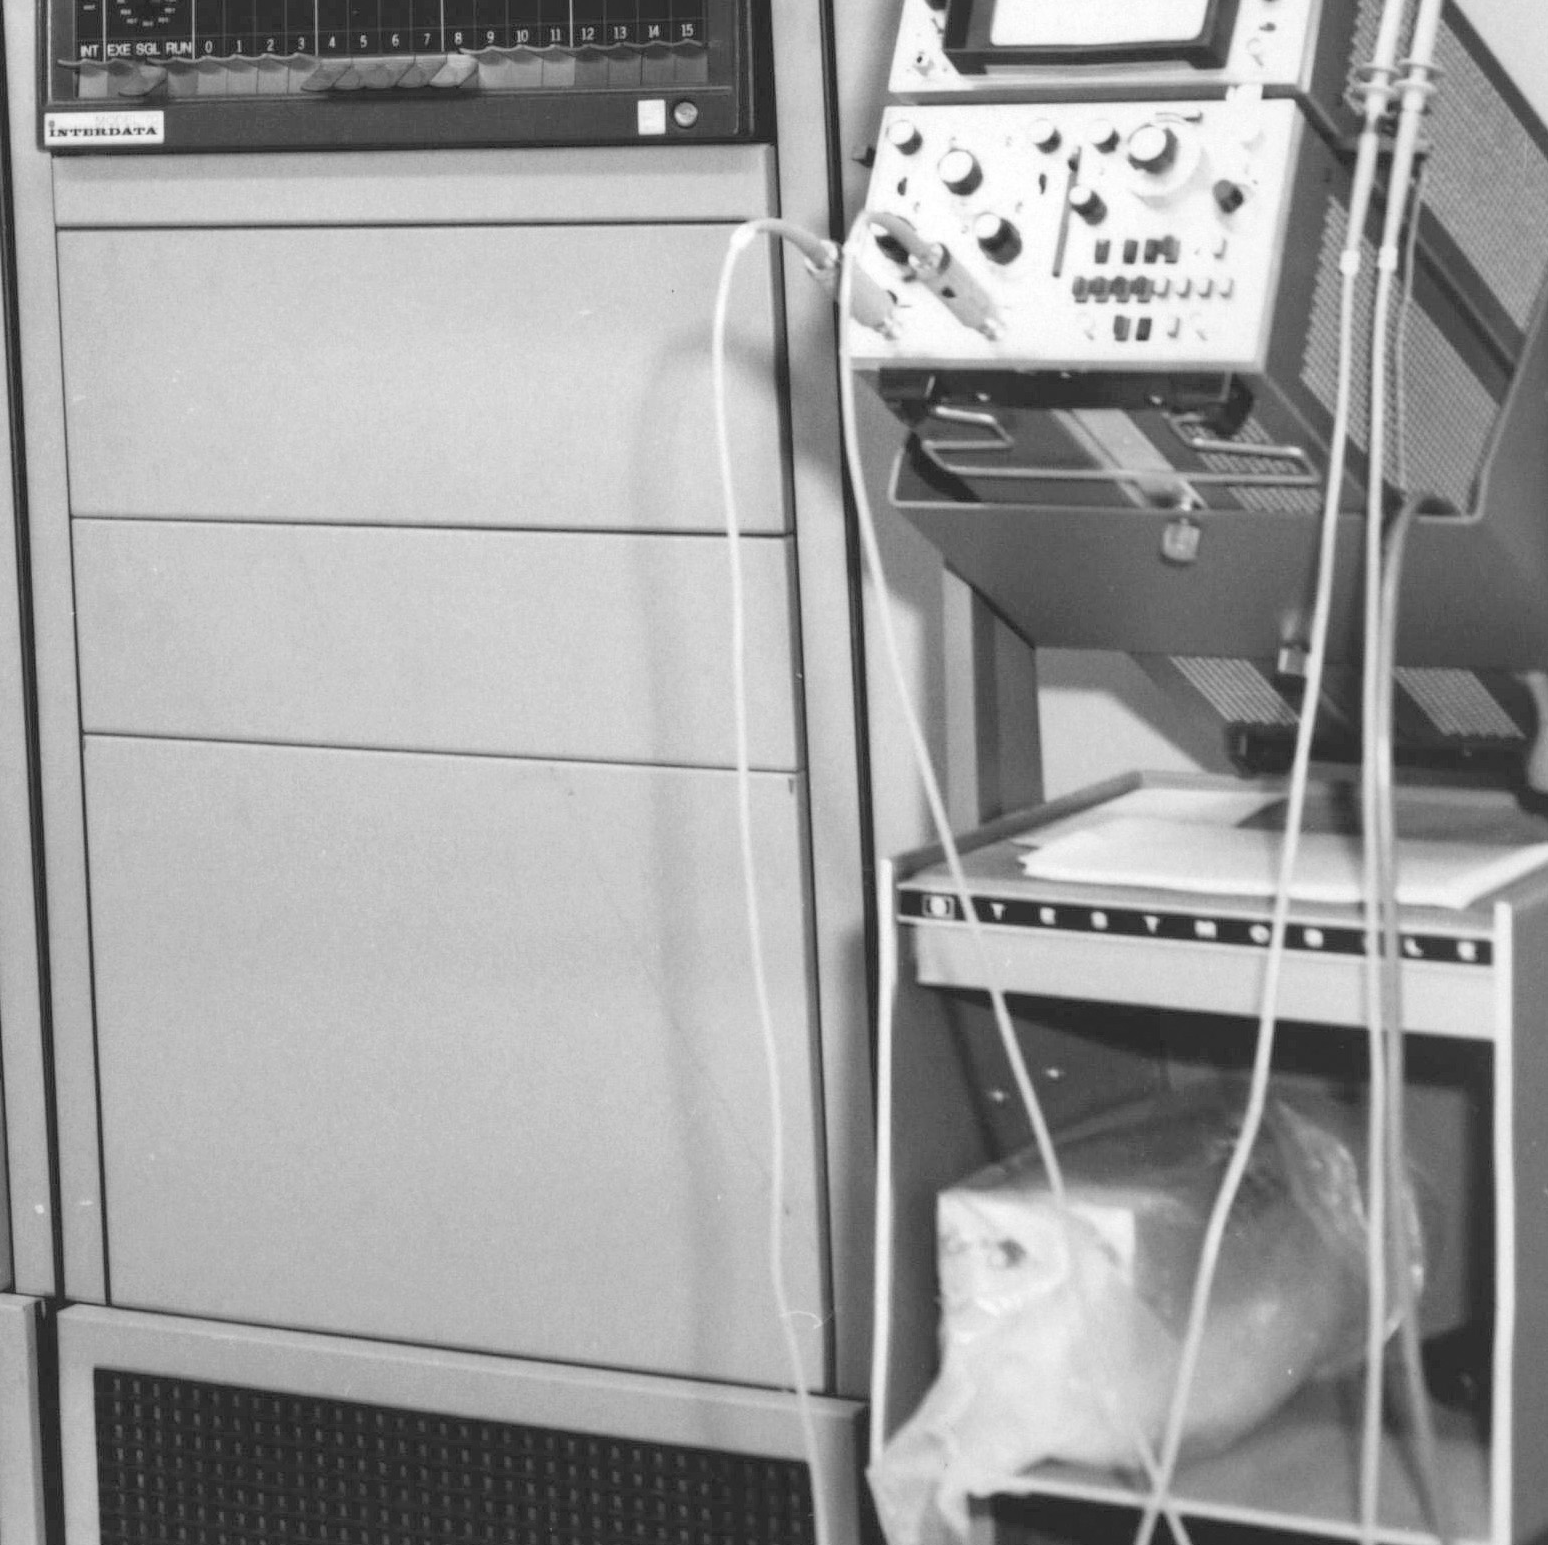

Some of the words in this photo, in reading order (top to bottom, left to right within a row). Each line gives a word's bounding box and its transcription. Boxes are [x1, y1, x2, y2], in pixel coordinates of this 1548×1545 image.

[80, 44, 99, 58] INT
[107, 43, 131, 57] EXE
[135, 42, 161, 56] SGL
[165, 40, 192, 55] RUN
[203, 40, 213, 54] 0
[265, 38, 275, 52] 2
[296, 37, 305, 51] 3
[327, 35, 337, 49] 4
[358, 34, 368, 48] 5
[390, 33, 400, 47] 6
[422, 32, 431, 46] 7
[453, 31, 463, 45] 8
[485, 30, 495, 44] 9
[515, 29, 529, 43] 10
[549, 28, 561, 42] 11
[580, 27, 595, 41] 12
[612, 26, 627, 40] 13
[647, 24, 660, 38] 14
[680, 23, 694, 37] 15
[48, 120, 158, 138] INTERDATA
[989, 901, 1478, 963] TESTMOBLE
